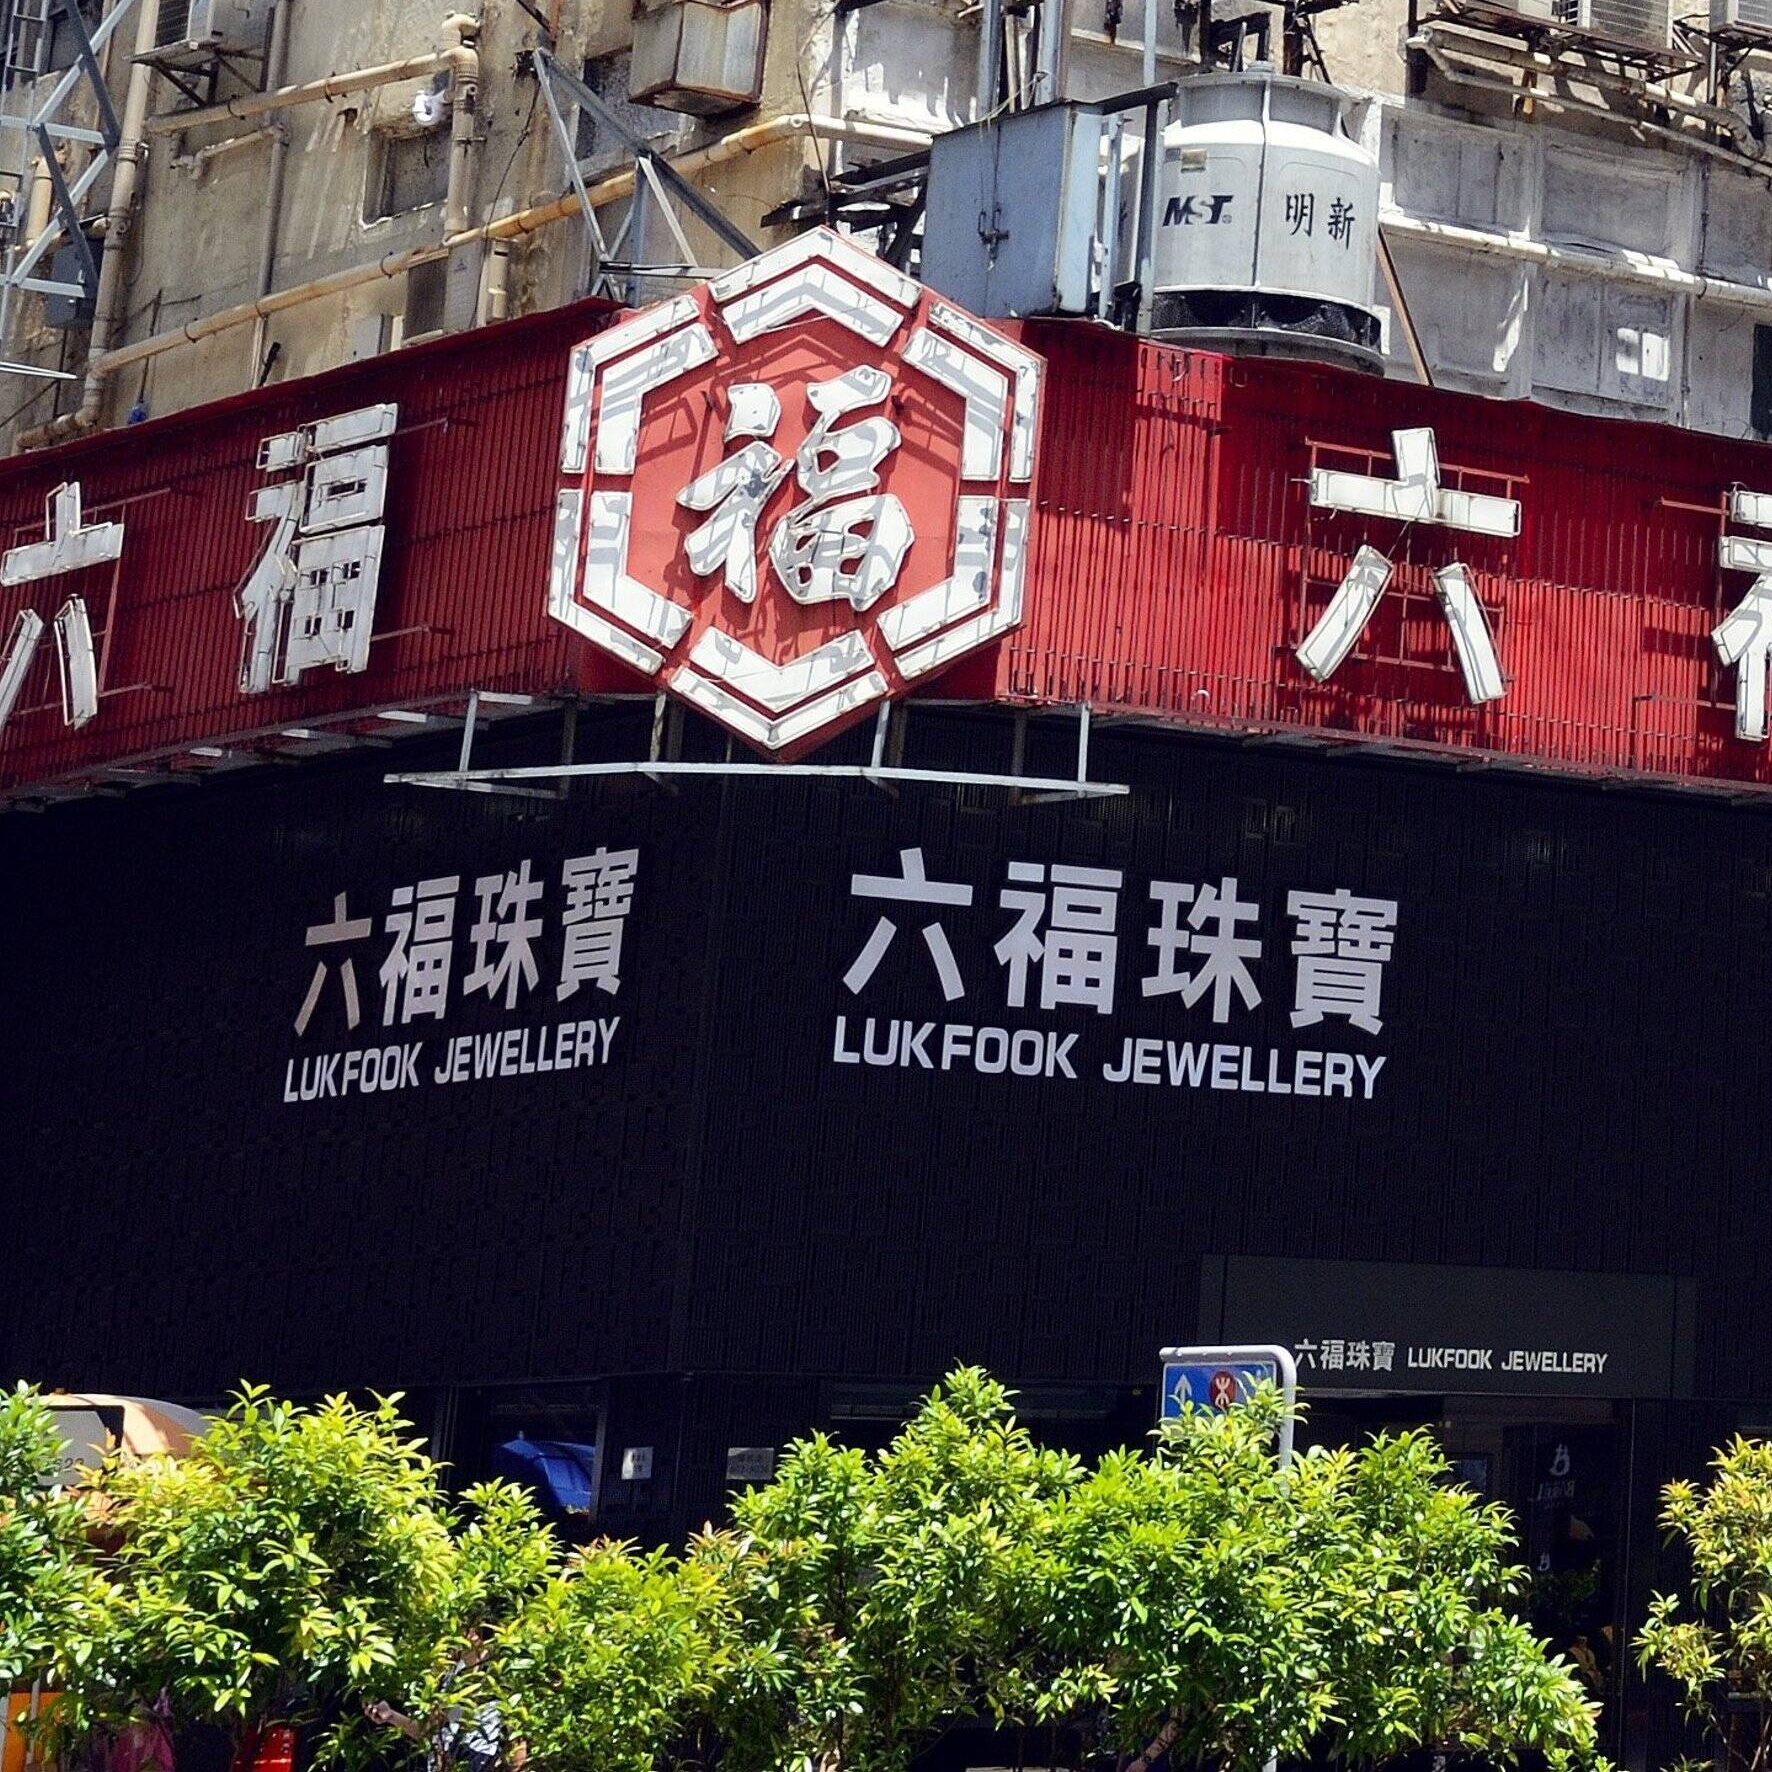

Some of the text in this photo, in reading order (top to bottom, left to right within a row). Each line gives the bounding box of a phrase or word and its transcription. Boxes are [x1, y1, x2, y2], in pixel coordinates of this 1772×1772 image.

[1162, 194, 1233, 227] MST
[1286, 192, 1356, 250] 明新
[675, 365, 914, 611] 福
[0, 402, 399, 729] 六福
[293, 845, 640, 1037] 六福珠寶
[842, 847, 1399, 1037] 六福珠寶
[283, 1016, 621, 1103] LUKFOOK JEWELLERY
[833, 1015, 1387, 1100] LUKFOOK JEWELLERY
[1294, 1337, 1396, 1374] 六福珠寶
[1407, 1346, 1608, 1376] LUKFOOK JEWELLERY
